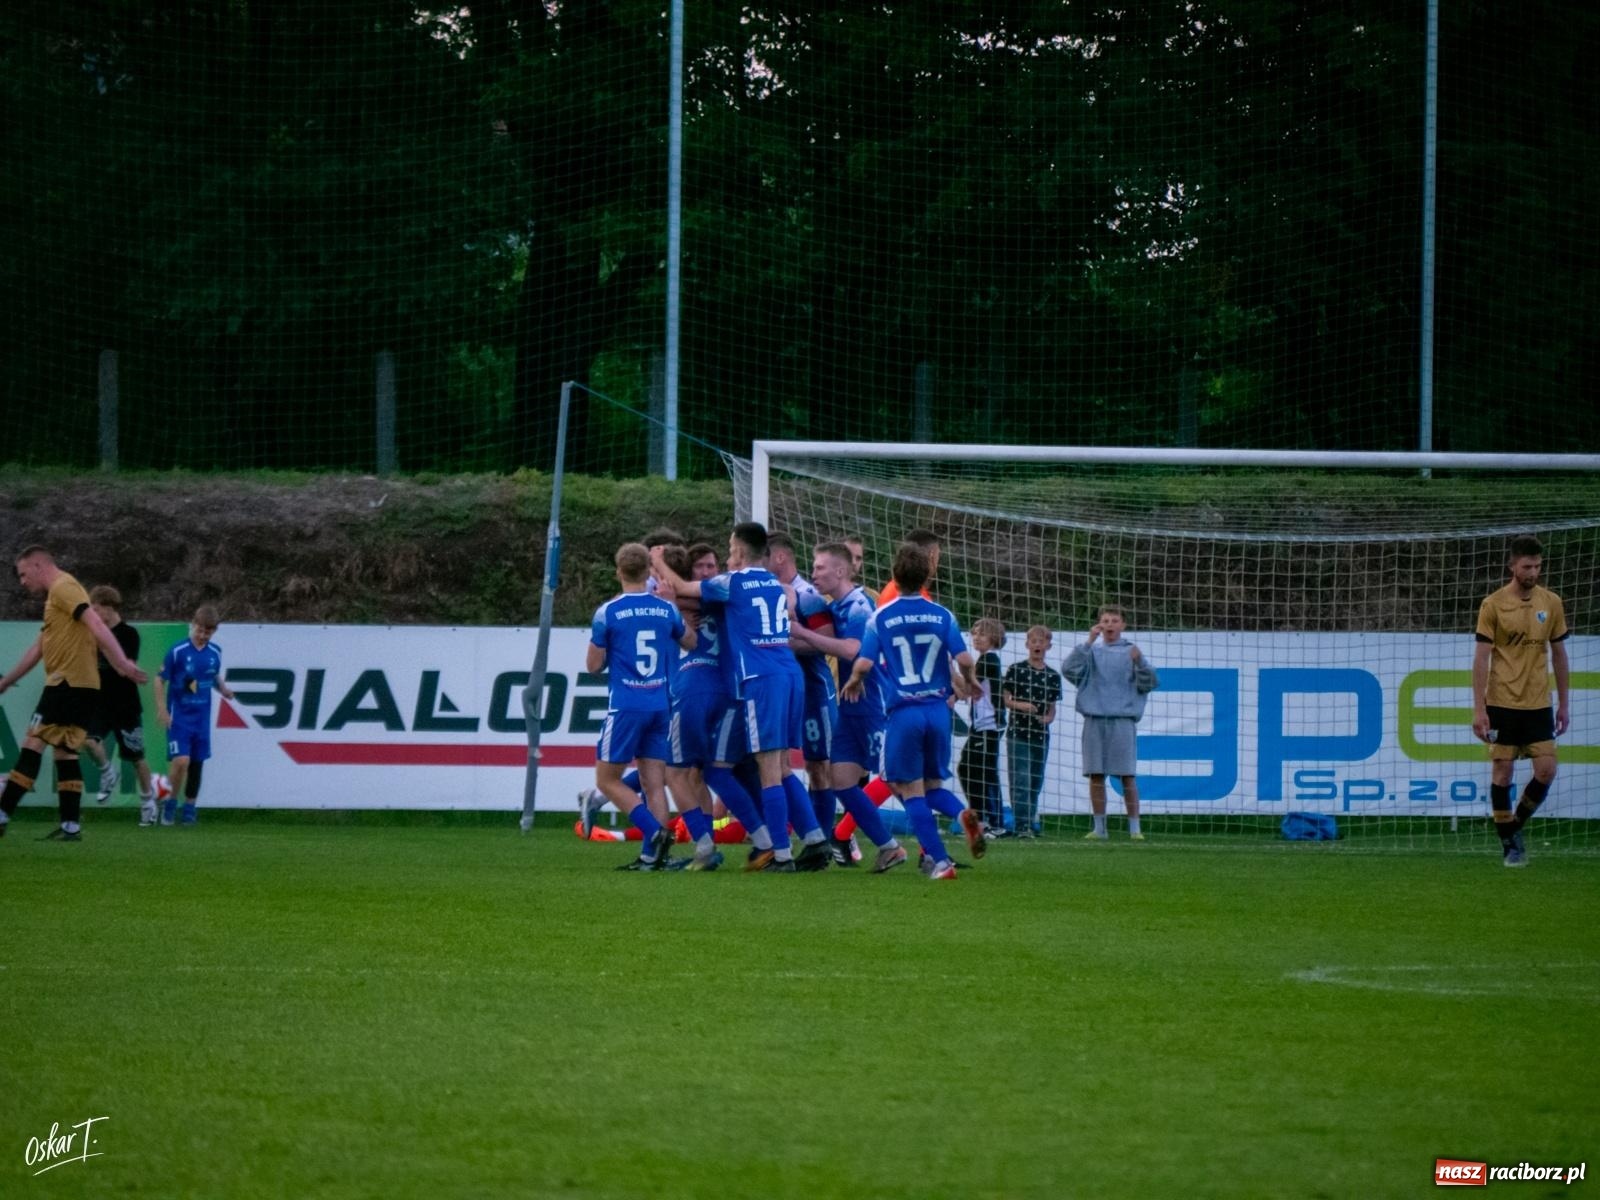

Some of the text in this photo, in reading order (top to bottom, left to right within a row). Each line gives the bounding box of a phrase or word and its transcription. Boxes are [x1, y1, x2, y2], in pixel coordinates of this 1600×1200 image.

[635, 629, 658, 678] 5
[892, 633, 943, 686] 17
[805, 719, 820, 741] 8
[1294, 770, 1396, 811] Sp.
